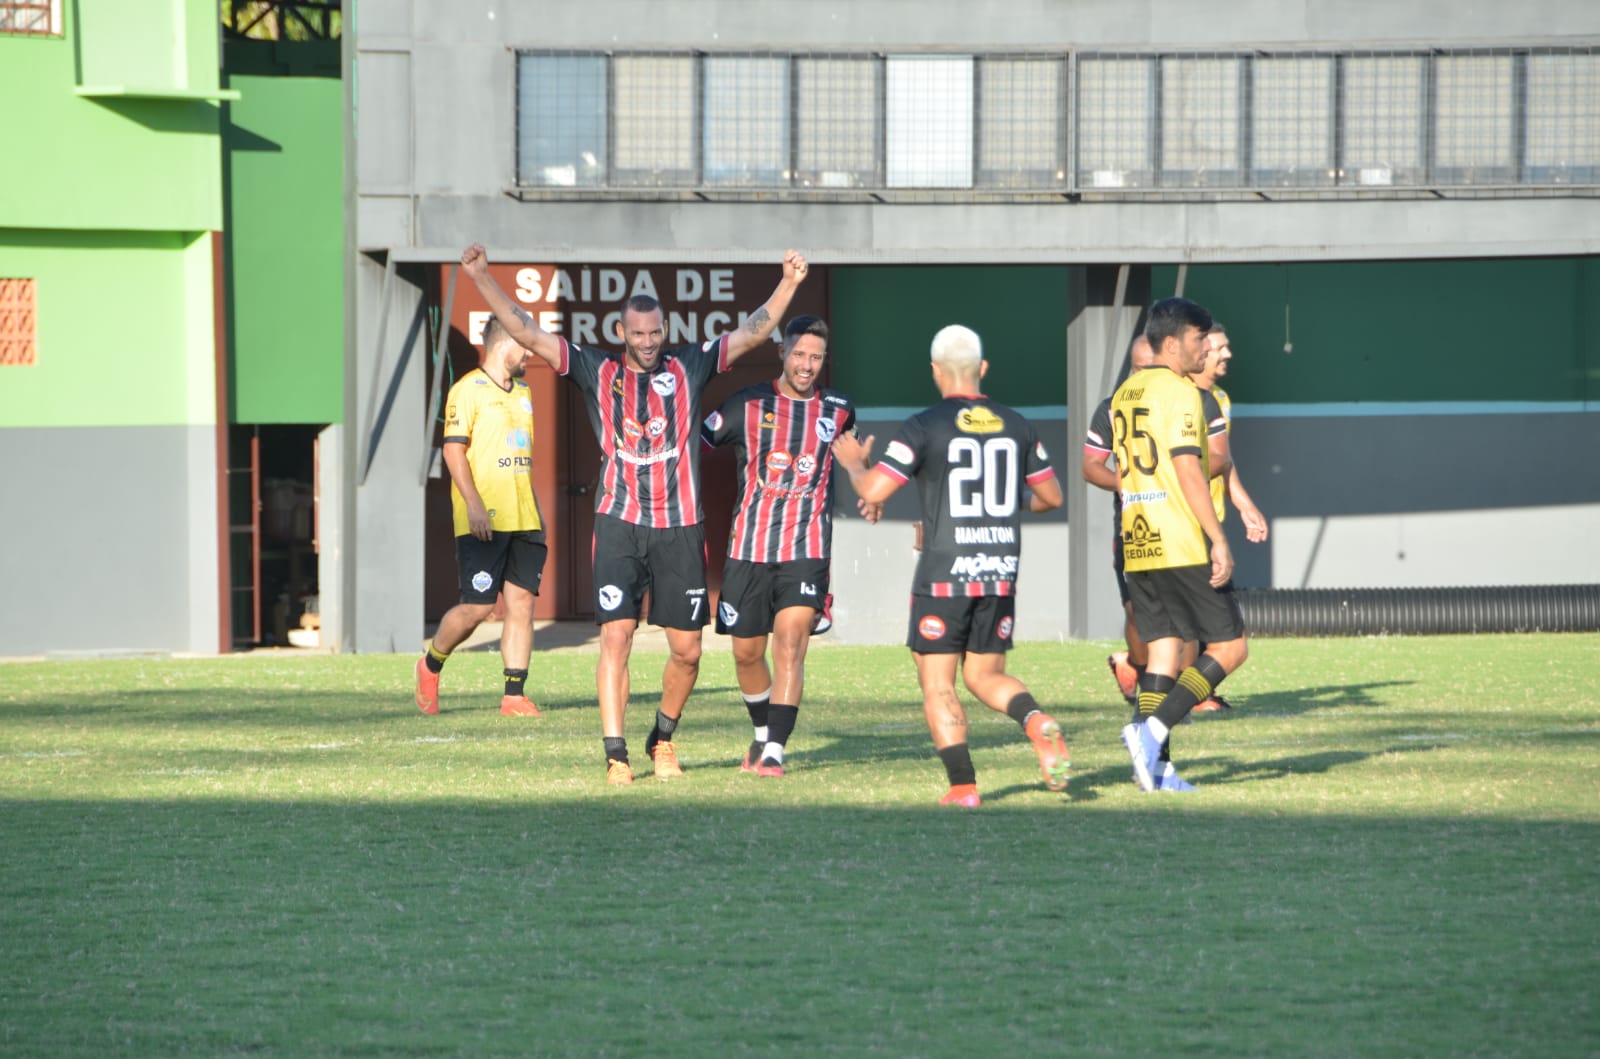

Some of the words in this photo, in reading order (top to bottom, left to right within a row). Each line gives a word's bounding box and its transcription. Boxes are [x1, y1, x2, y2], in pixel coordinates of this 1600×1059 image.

[676, 270, 735, 302] DE
[468, 310, 784, 345] EERGNC
[948, 437, 1017, 518] 20
[954, 526, 1015, 544] HAMILTON
[690, 597, 702, 621] 7
